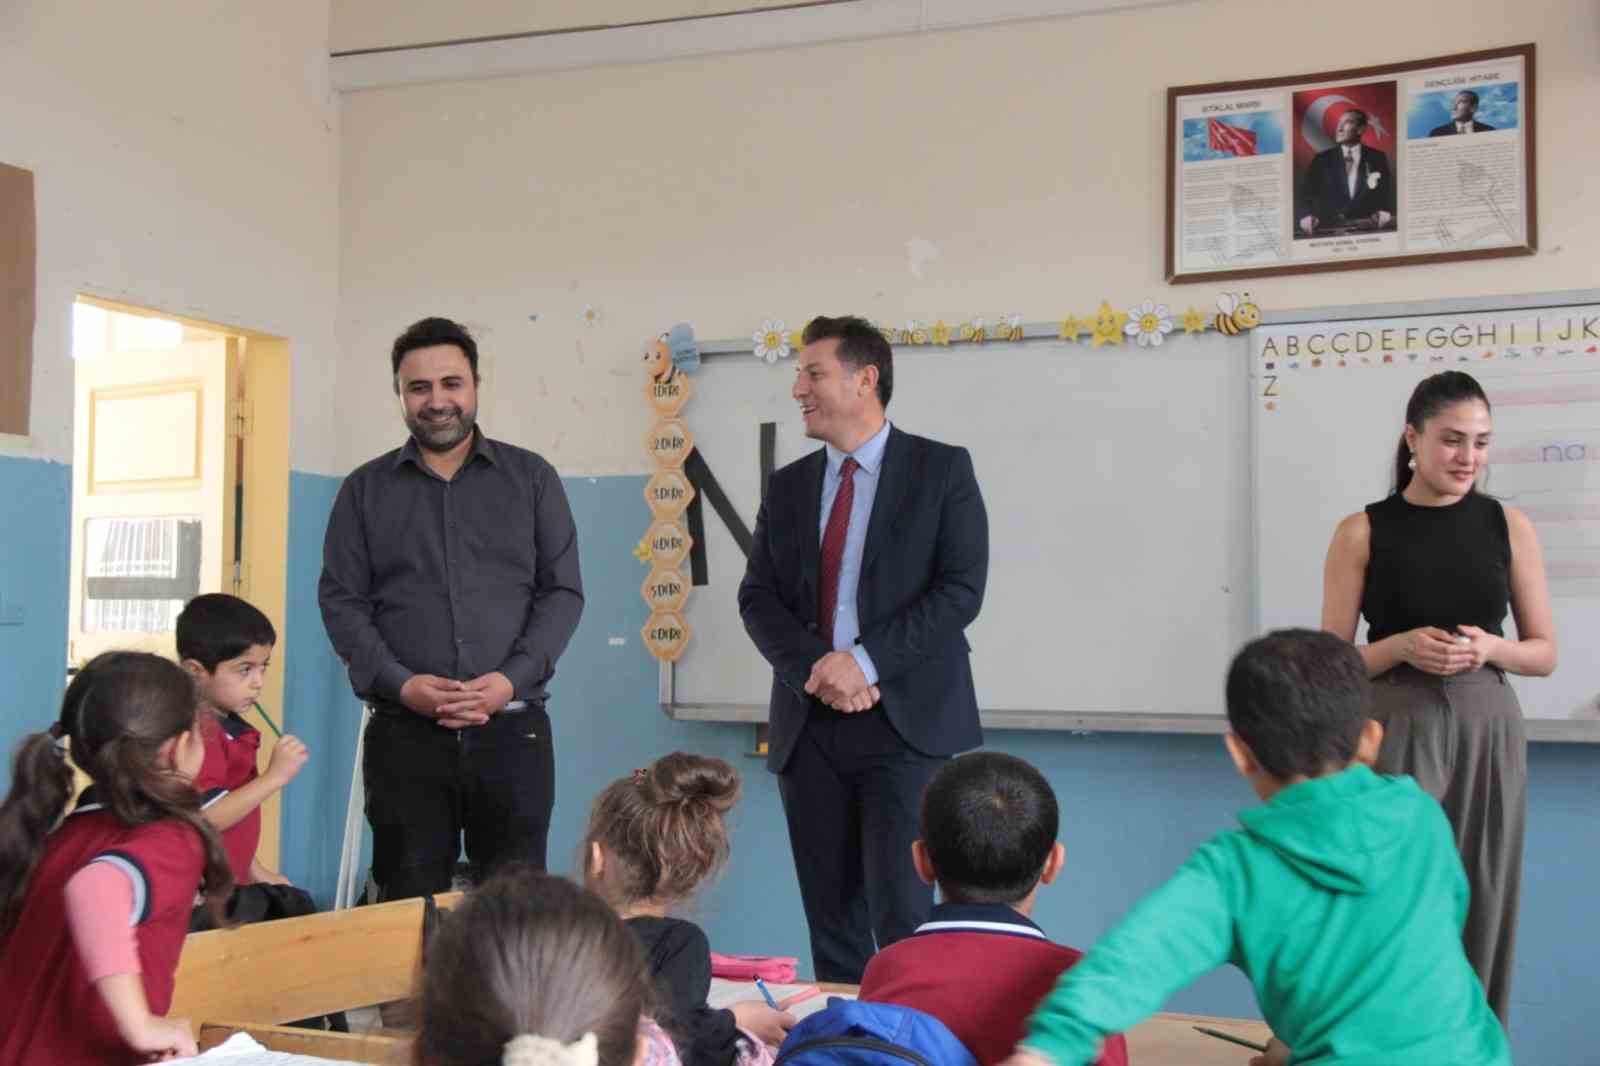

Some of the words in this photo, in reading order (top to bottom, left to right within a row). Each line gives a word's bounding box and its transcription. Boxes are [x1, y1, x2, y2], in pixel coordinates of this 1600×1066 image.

[1262, 336, 1280, 357] A
[1286, 335, 1300, 357] B
[1307, 333, 1326, 355] C
[1355, 331, 1373, 353] D
[1381, 328, 1396, 351] E
[1406, 327, 1420, 350] F
[1425, 326, 1448, 349] G
[1477, 322, 1497, 345] H
[1557, 318, 1572, 341] J
[1582, 317, 1600, 339] K
[1263, 375, 1278, 397] Z
